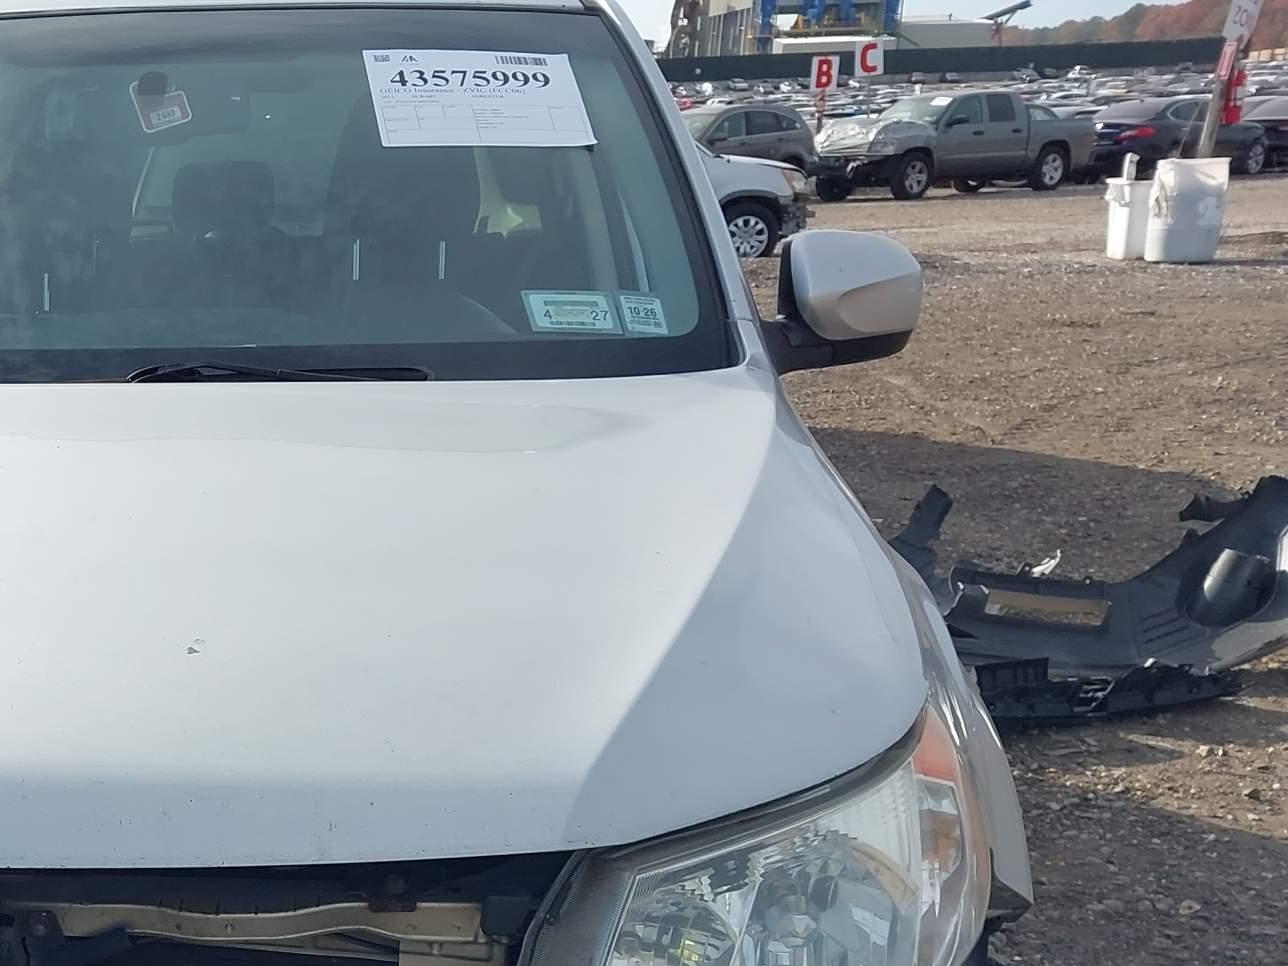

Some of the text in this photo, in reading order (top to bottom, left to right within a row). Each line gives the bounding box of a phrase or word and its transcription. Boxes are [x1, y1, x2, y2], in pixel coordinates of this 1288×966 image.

[860, 42, 878, 73] C
[390, 69, 551, 89] 43575999
[815, 59, 833, 89] B
[543, 309, 553, 320] 4
[590, 310, 609, 321] 27
